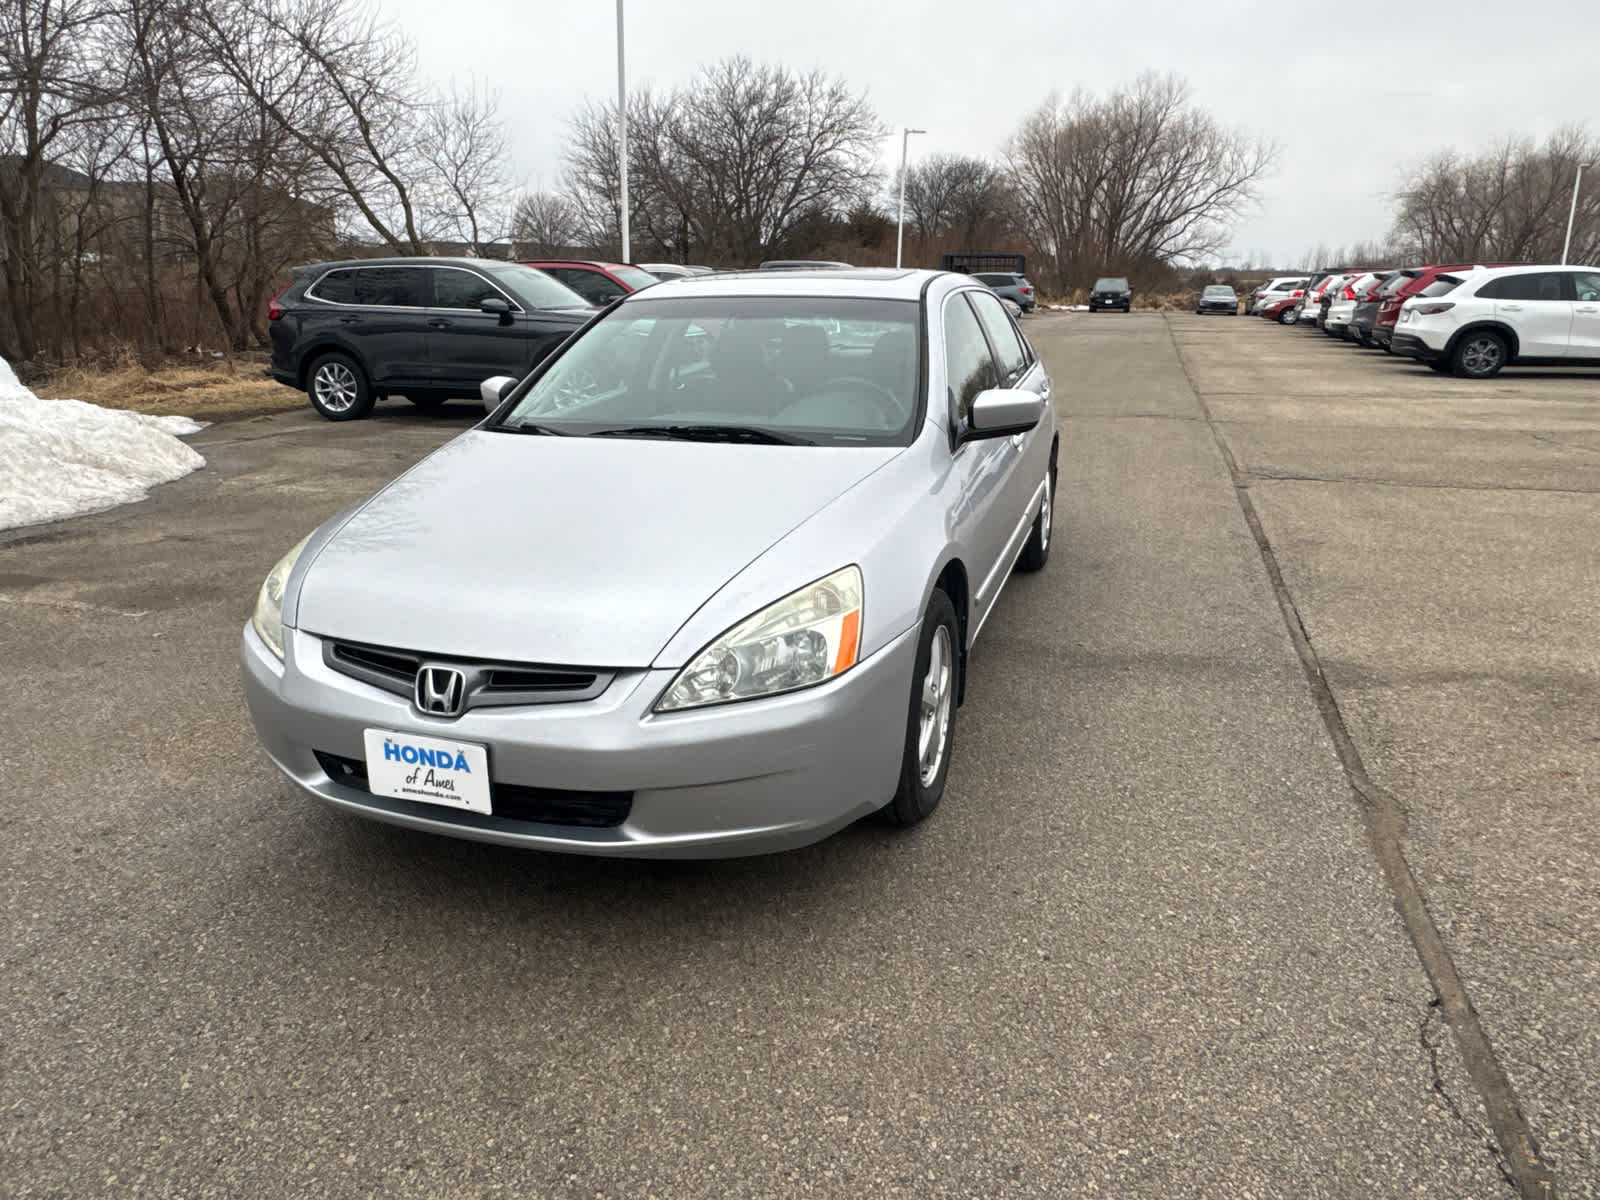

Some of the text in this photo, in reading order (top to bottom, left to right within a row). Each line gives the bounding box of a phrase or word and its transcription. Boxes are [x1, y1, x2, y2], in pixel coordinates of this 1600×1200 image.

[384, 742, 471, 773] HONDA
[406, 767, 455, 791] of Ames
[402, 787, 462, 801] ameshonda.com
